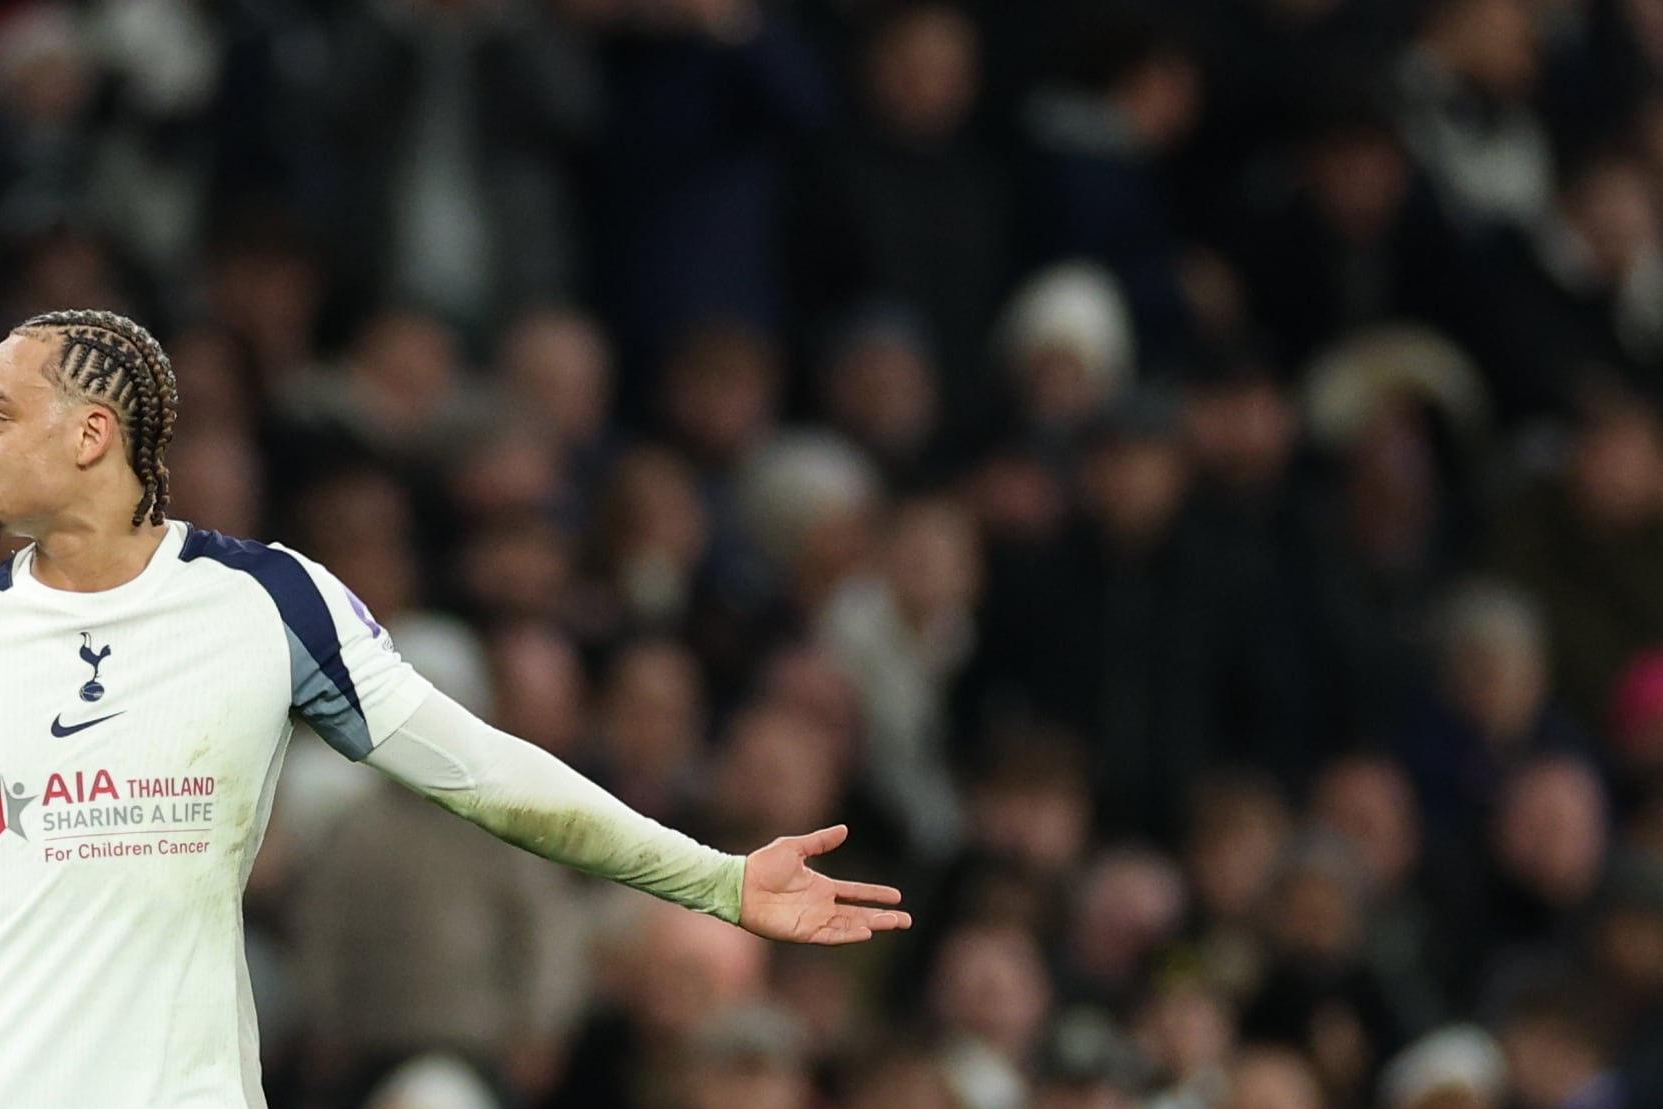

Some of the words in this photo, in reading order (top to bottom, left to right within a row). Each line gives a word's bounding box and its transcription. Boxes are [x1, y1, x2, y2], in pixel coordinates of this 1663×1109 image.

[42, 769, 120, 806] AIA
[127, 776, 215, 799] THAILAND
[43, 804, 144, 831] SHARING
[150, 805, 166, 824] A
[172, 802, 213, 823] LIFE
[44, 847, 73, 863] For
[78, 841, 153, 860] Children
[157, 836, 210, 855] Cancer
